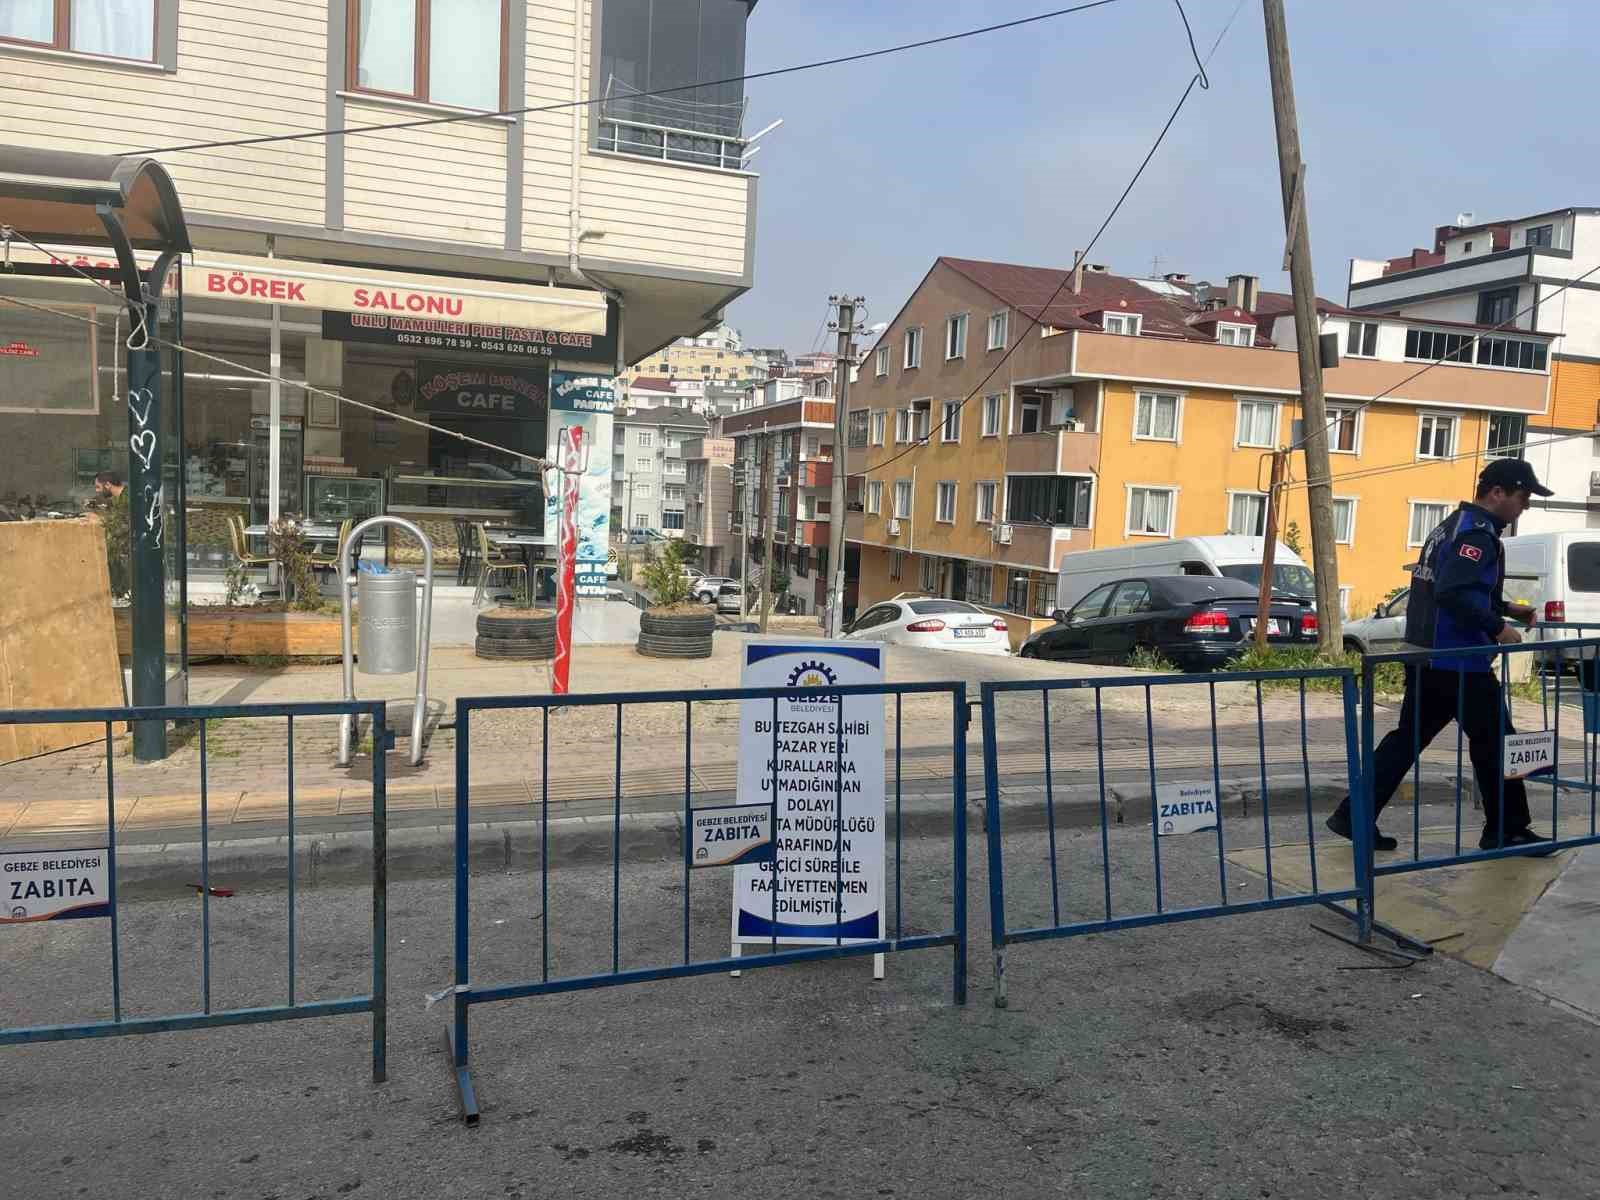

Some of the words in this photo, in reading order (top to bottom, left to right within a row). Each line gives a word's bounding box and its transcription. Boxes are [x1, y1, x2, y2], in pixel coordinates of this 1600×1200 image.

[207, 271, 305, 301] BÖREK
[353, 288, 463, 316] SALONU
[504, 327, 544, 343] PASTA
[559, 333, 592, 347] CAFE
[481, 341, 504, 351] 0543
[457, 391, 515, 410] CAFE
[580, 576, 606, 584] CAFE
[754, 720, 773, 733] BU
[775, 721, 825, 734] TEZGAH
[828, 720, 870, 735] SAHİBİ
[775, 740, 817, 753] PAZAR
[1510, 750, 1548, 764] ZABITA
[767, 759, 856, 773] KURALLARINA
[761, 776, 861, 793] UYMADIĞINDAN
[787, 799, 834, 812] DOLAYI
[1160, 801, 1214, 817] ZABITA
[696, 816, 723, 827] GEBZE
[724, 812, 767, 824] BELEDİYESİ
[795, 816, 875, 832] MÜDÜRLÜĞÜ
[704, 825, 761, 842] ZABITA
[776, 838, 852, 852] ARAFINDAN
[4, 862, 40, 872] GEBZE
[42, 856, 101, 870] BELEDİYESİ
[759, 856, 802, 874] GEÇİCİ
[804, 857, 838, 873] SÜRE
[841, 858, 861, 873] İLE
[10, 878, 95, 900] ZABITA
[751, 877, 837, 893] FAALİYETTEN
[840, 880, 868, 893] MEN
